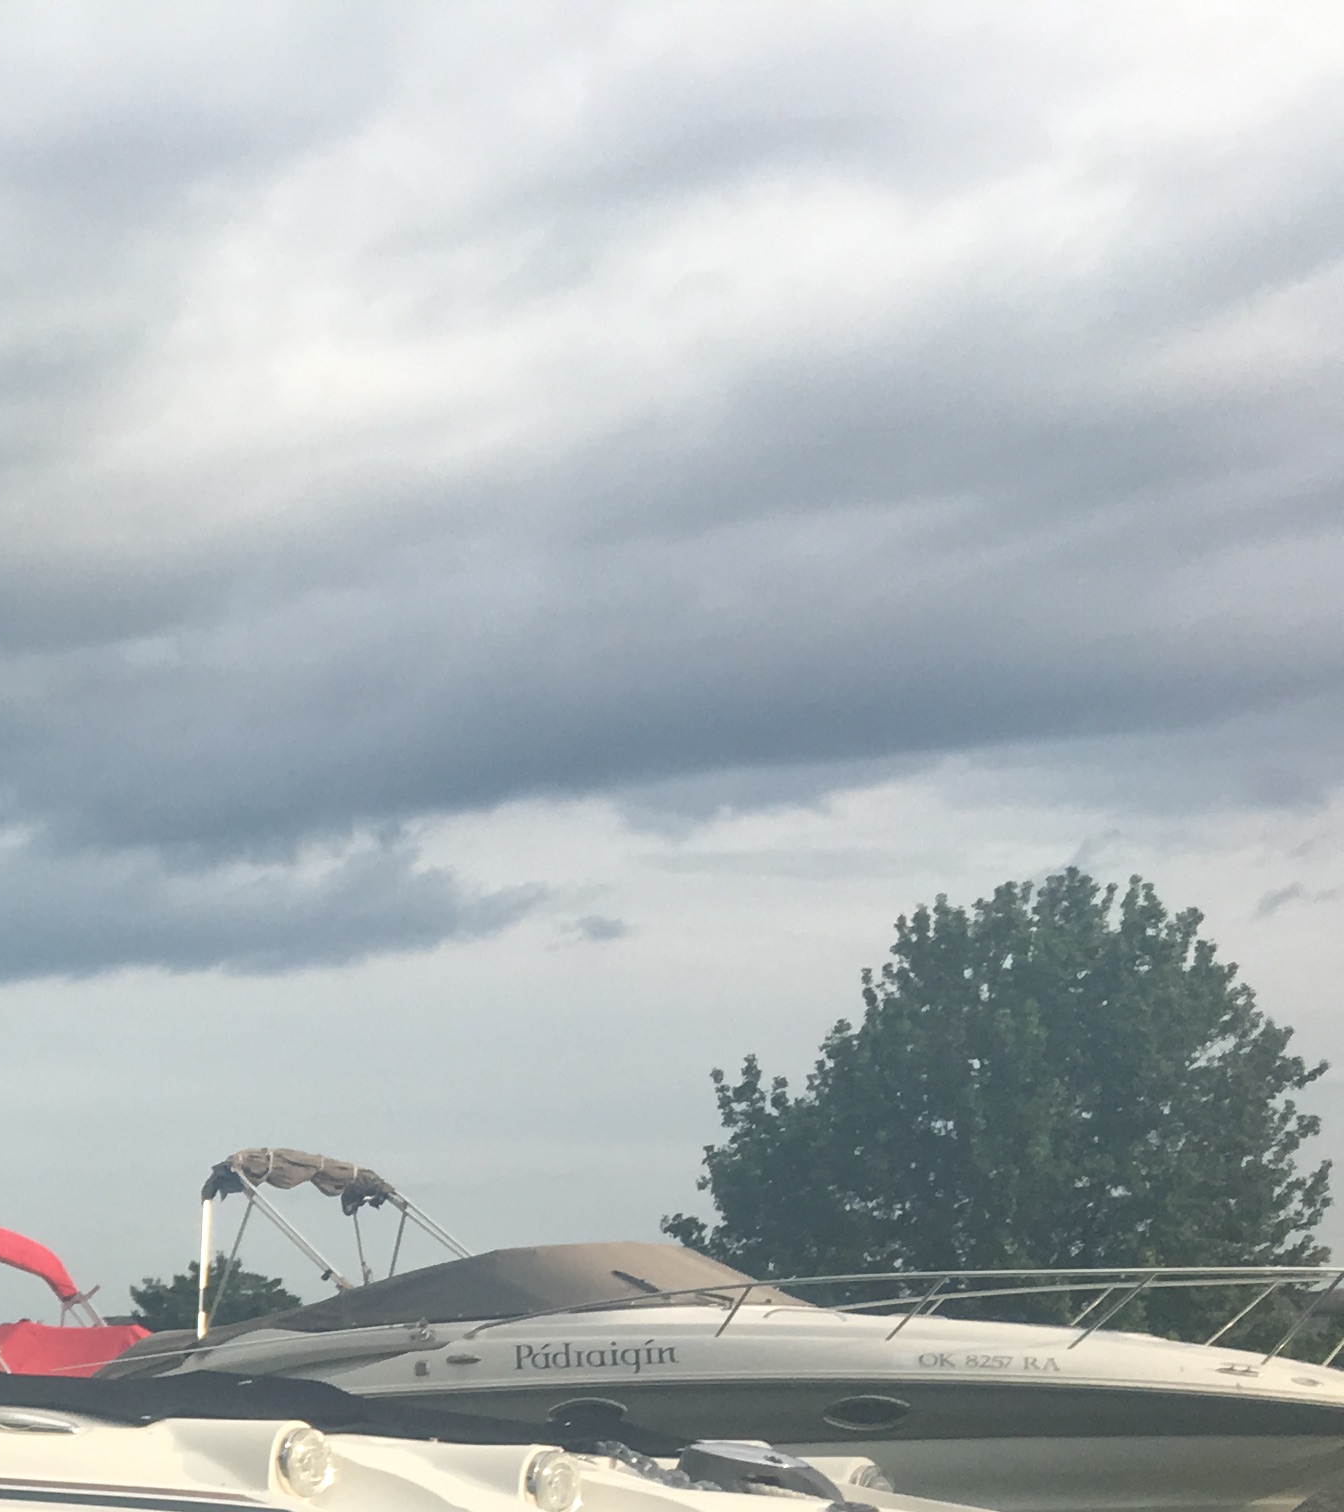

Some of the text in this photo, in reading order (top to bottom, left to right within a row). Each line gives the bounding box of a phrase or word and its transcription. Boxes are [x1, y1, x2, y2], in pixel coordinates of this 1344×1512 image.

[918, 1352, 1060, 1372] OK 8257 RA
